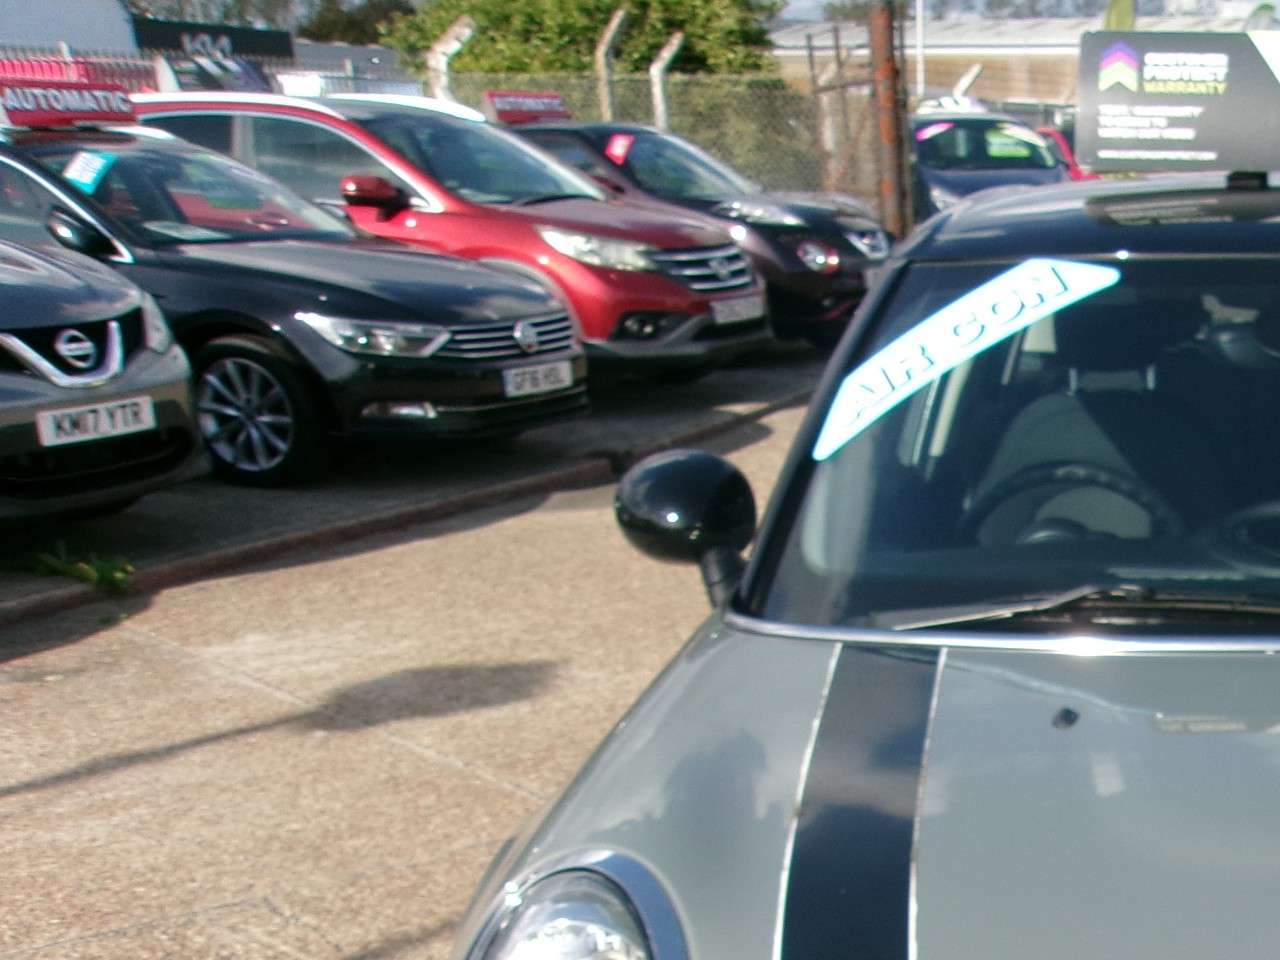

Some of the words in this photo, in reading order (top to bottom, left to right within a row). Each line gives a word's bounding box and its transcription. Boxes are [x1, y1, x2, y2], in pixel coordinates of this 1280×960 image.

[3, 86, 133, 113] AUTOMATIC
[1143, 81, 1227, 94] WARRANTY
[842, 344, 936, 428] AIR
[952, 264, 1069, 348] CON
[54, 409, 98, 437] KM17
[104, 401, 145, 426] YTR
